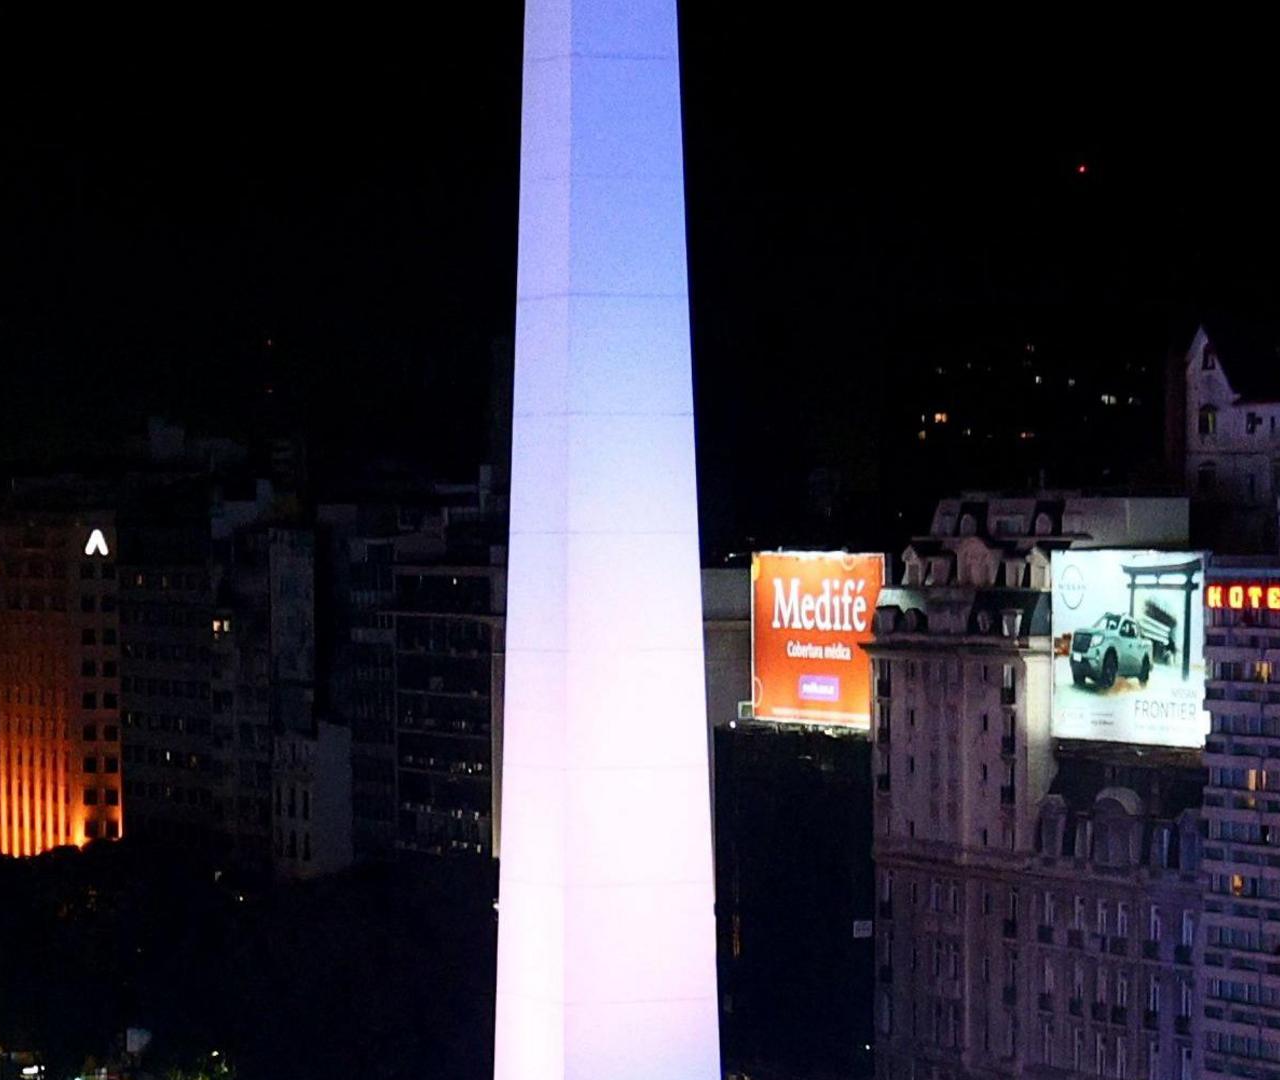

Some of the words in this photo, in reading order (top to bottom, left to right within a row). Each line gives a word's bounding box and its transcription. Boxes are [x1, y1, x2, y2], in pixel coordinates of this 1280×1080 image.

[772, 577, 867, 632] Medifé
[787, 640, 823, 659] Cobertura
[824, 642, 851, 660] médica
[1135, 700, 1196, 720] FRONTIER
